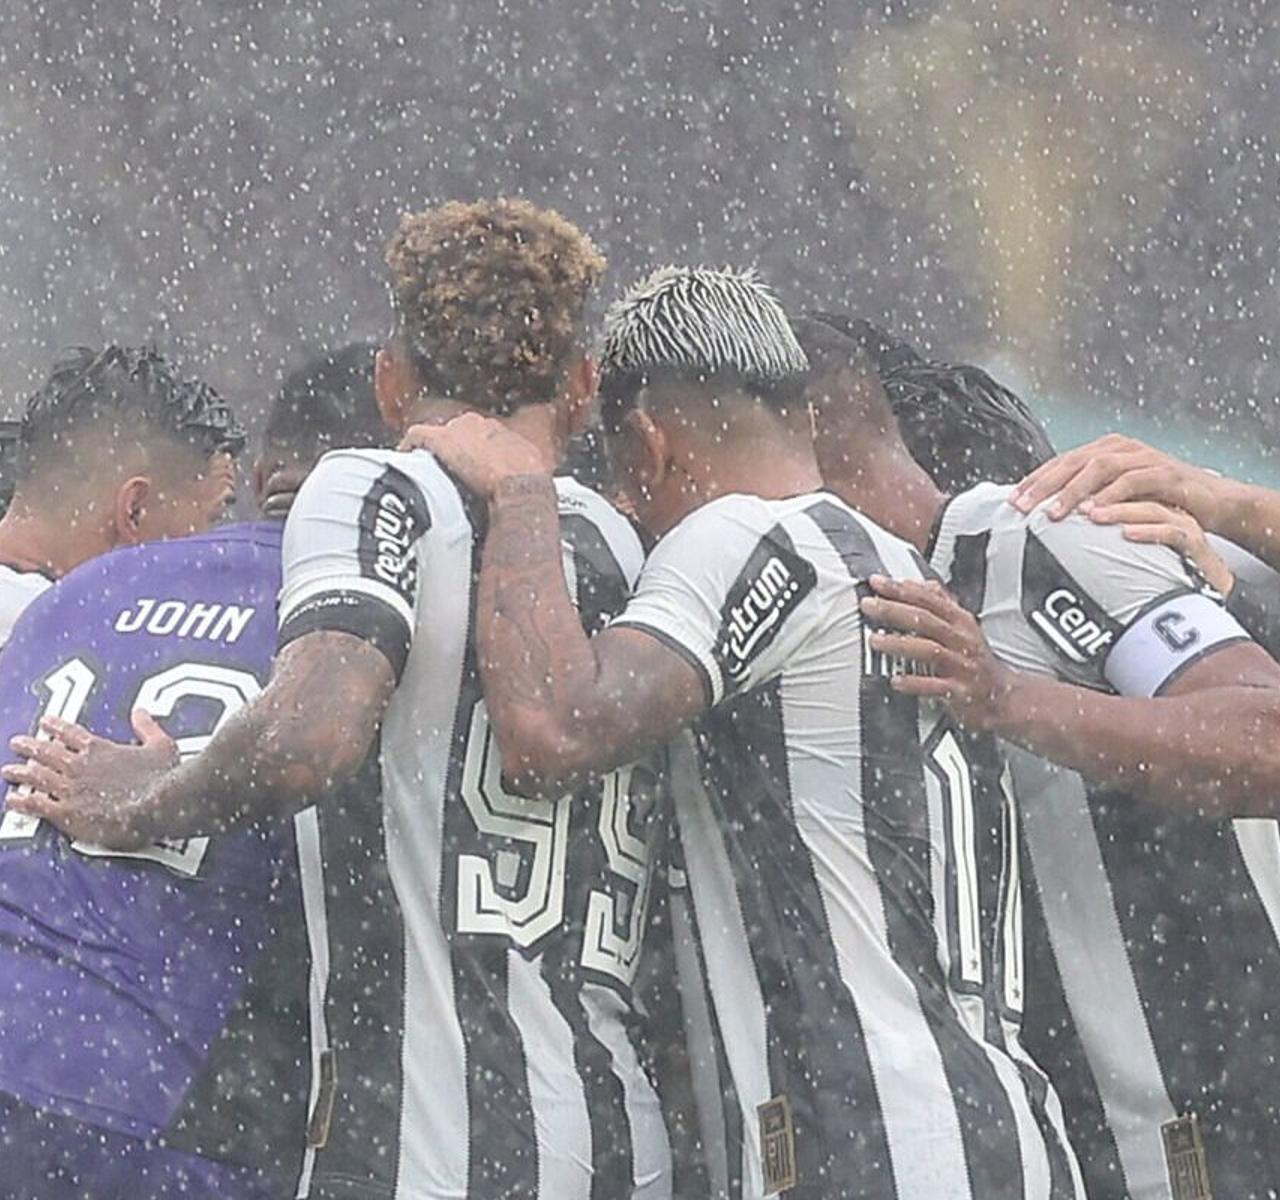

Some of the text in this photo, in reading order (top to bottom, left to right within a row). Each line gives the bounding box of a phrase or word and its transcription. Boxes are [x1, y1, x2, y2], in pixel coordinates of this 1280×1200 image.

[114, 599, 254, 643] JOHN
[1045, 590, 1113, 656] Cent
[1153, 611, 1200, 655] C
